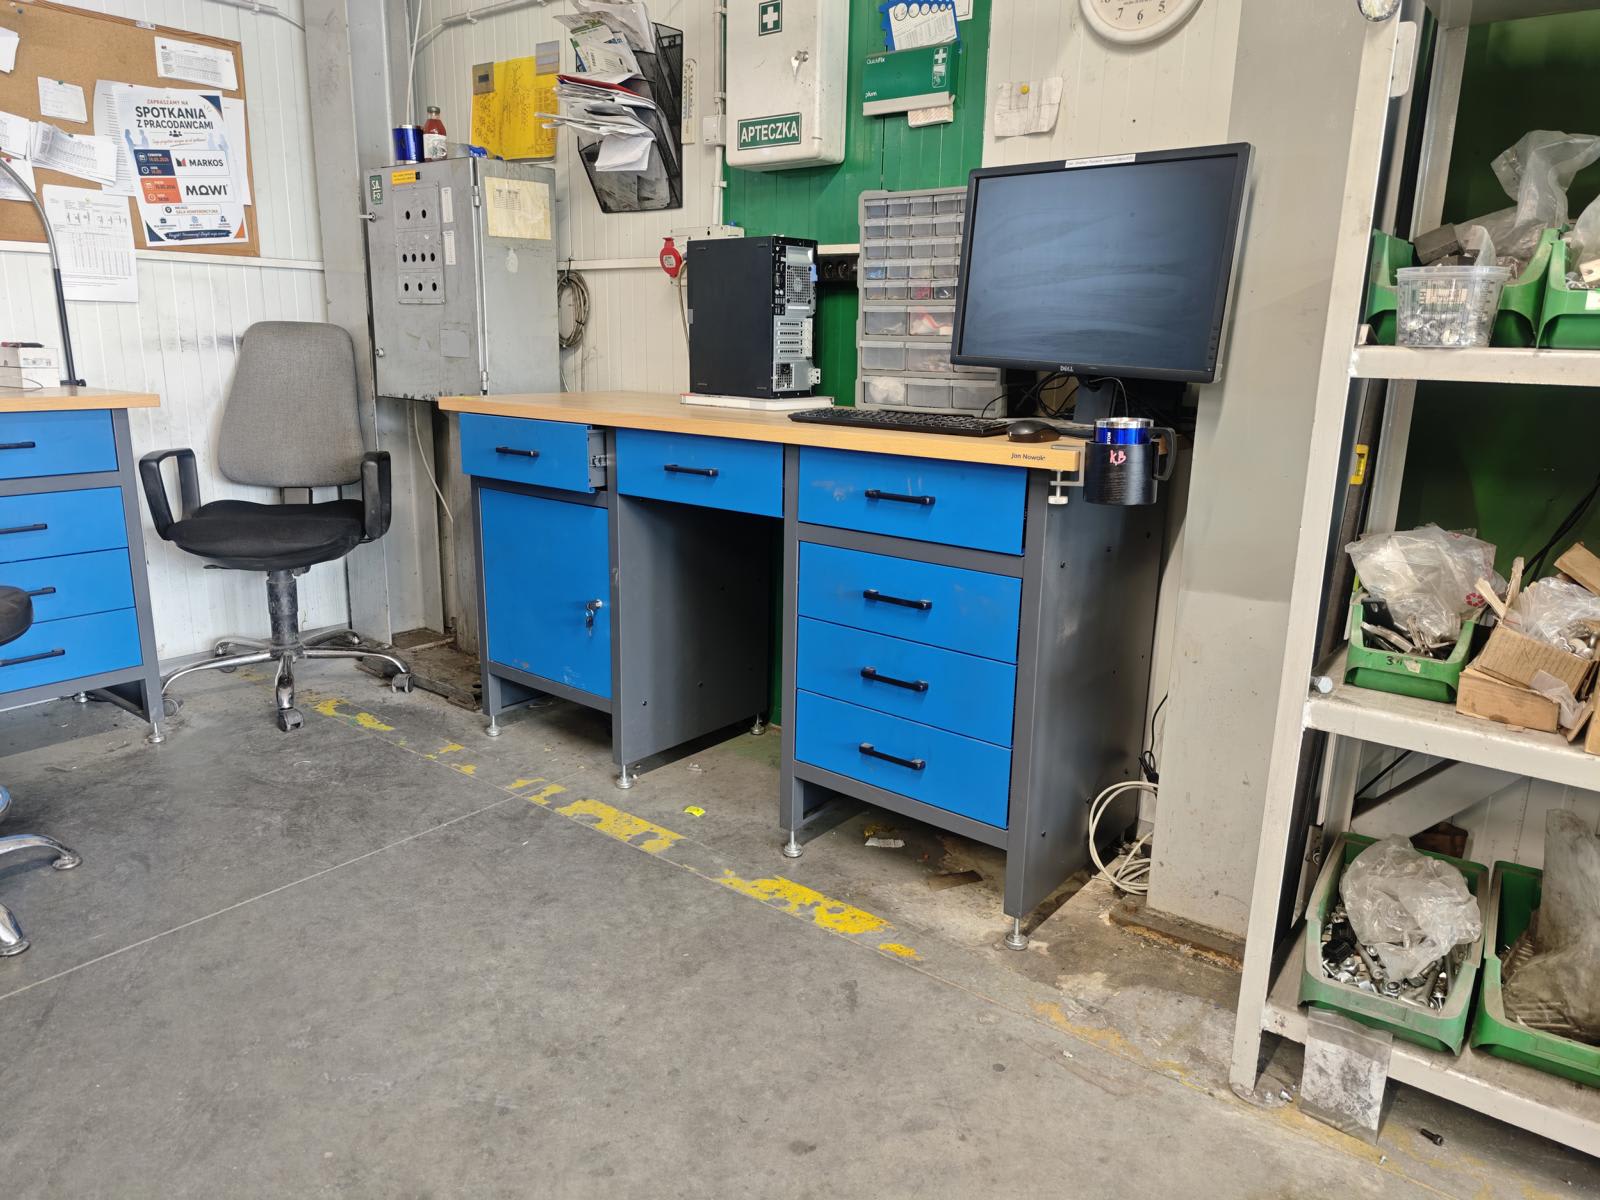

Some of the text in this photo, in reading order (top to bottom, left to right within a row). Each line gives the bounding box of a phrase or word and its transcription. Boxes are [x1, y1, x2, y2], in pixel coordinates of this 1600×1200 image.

[1158, 1, 1165, 12] 5
[1117, 7, 1124, 18] 7
[1137, 9, 1143, 20] 6
[135, 106, 206, 119] SPOTKANIA
[136, 119, 214, 130] Z PRACODAWCAMI
[740, 121, 798, 143] APTECZKA
[189, 159, 224, 167] MARKOS
